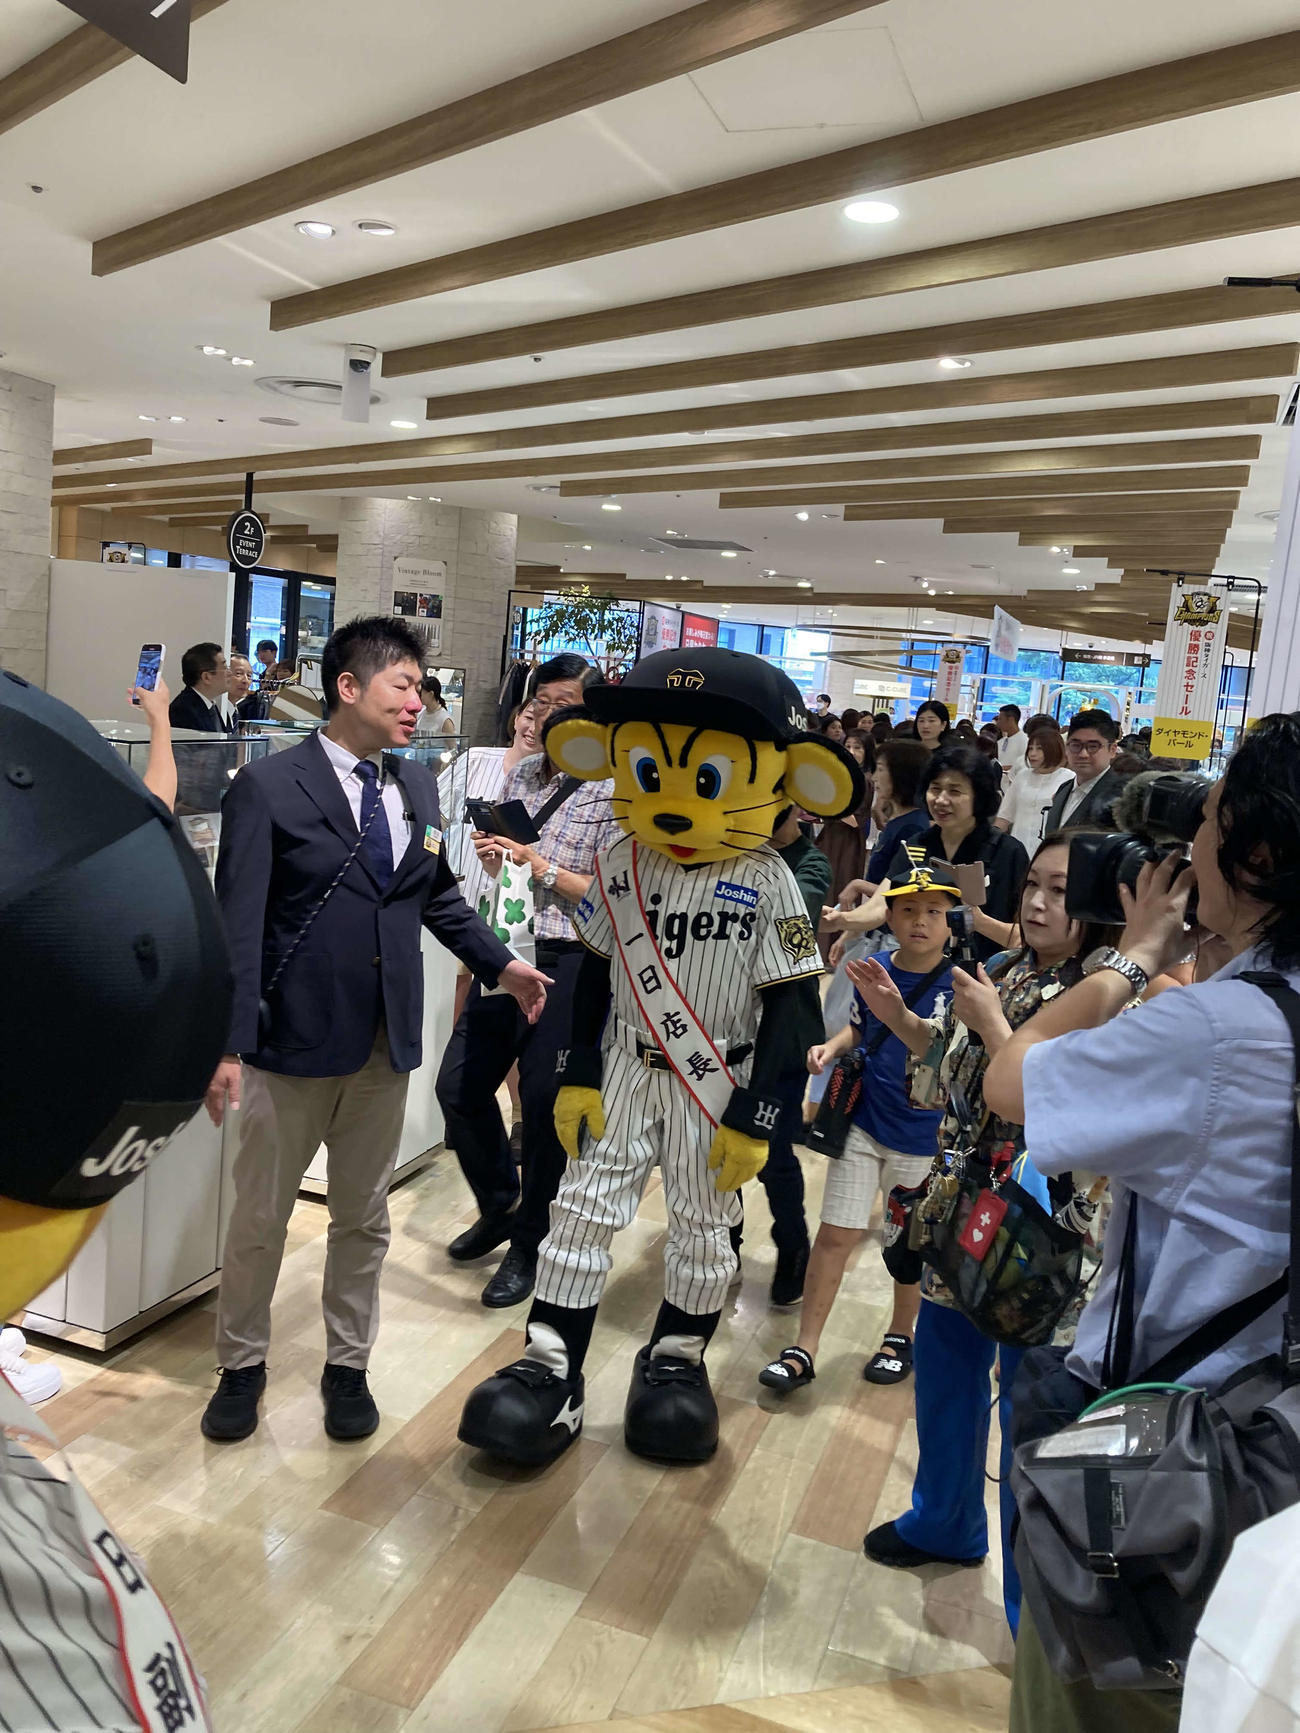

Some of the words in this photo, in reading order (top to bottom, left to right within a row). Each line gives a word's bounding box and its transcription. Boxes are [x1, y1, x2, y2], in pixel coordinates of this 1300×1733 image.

[239, 539, 256, 549] EVENT
[244, 522, 255, 535] 2F
[1179, 630, 1202, 716] 優勝記念セール
[716, 885, 757, 905] Joshin
[645, 892, 756, 959] igers
[624, 931, 720, 1082] 一日店長
